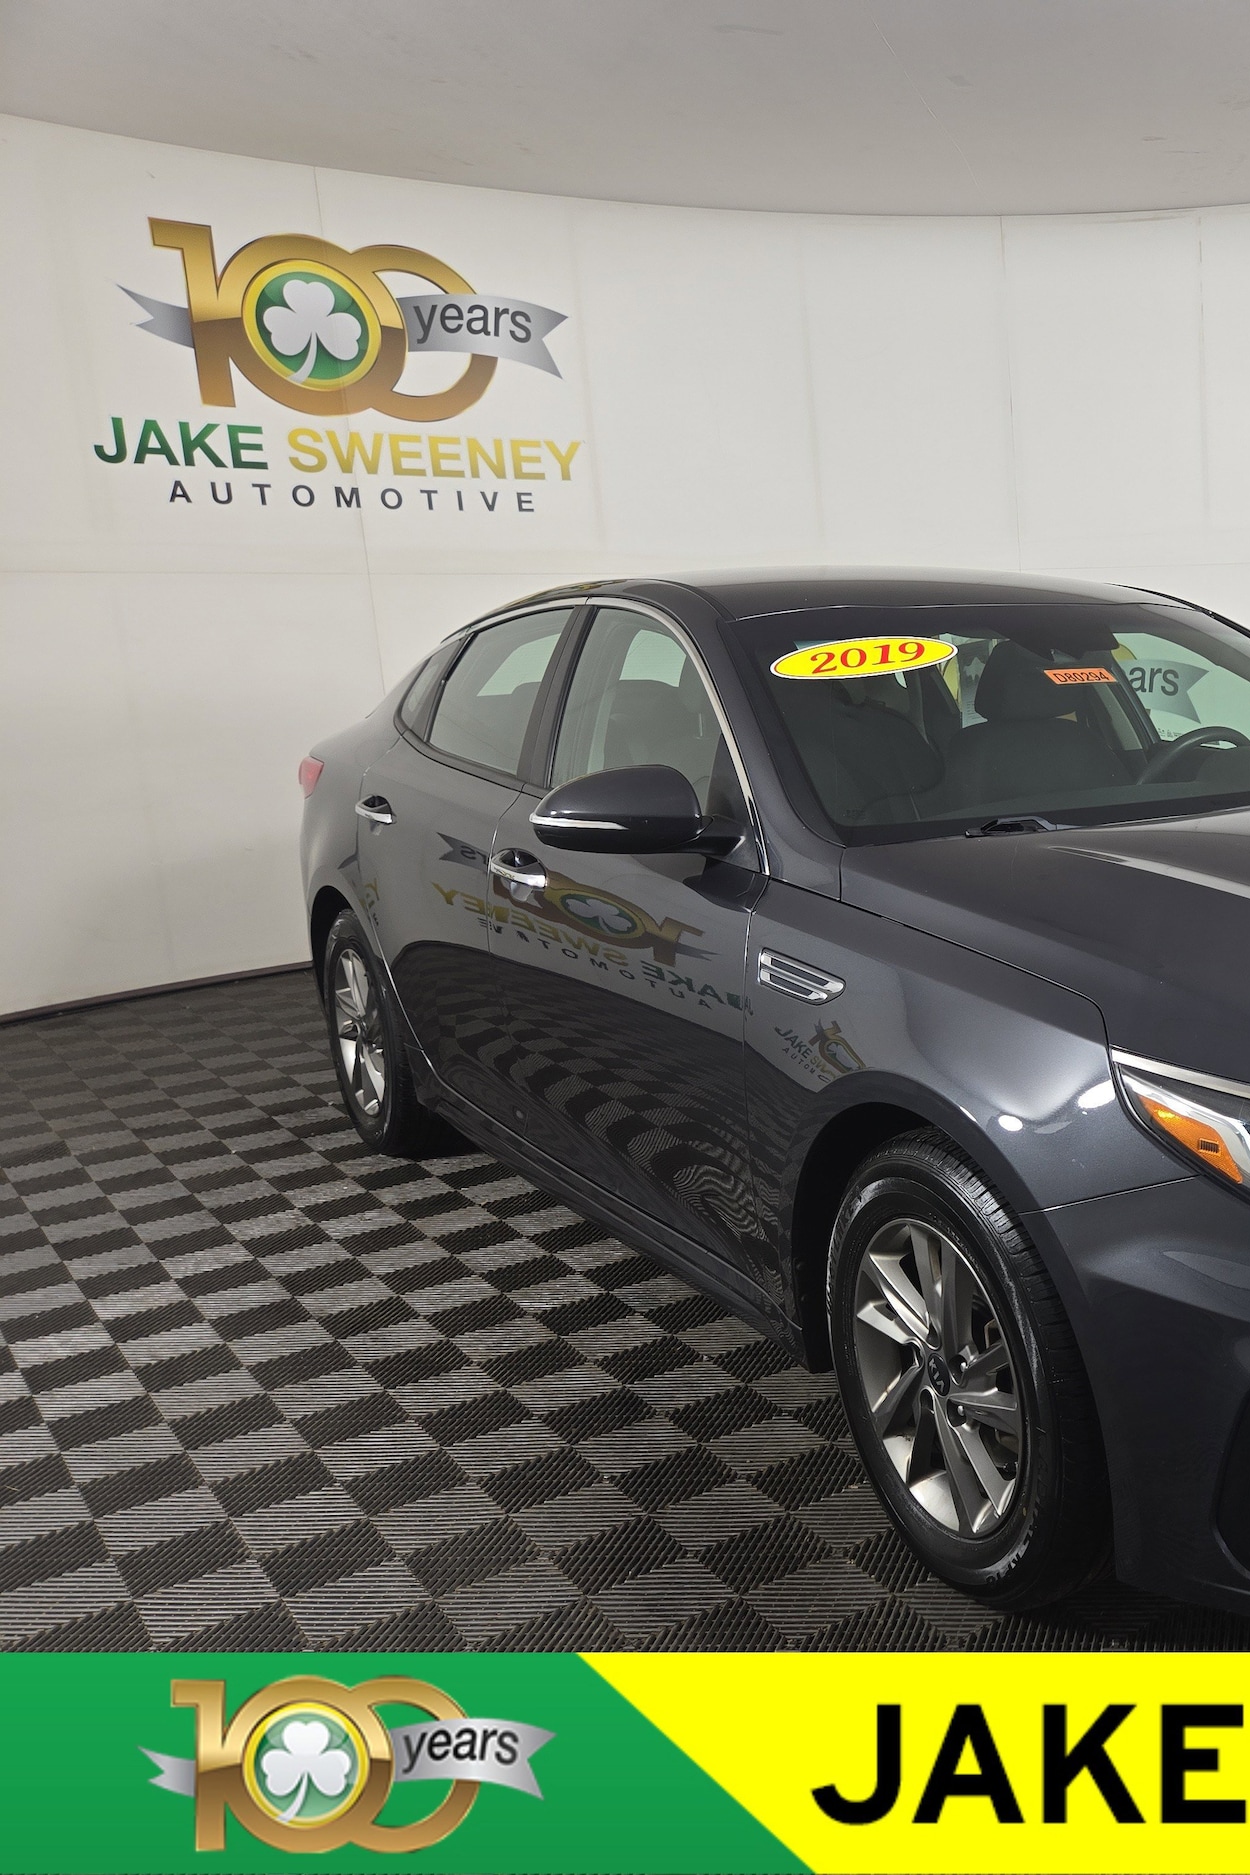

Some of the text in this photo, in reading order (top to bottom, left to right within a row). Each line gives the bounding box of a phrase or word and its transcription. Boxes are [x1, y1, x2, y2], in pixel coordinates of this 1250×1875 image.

[147, 217, 498, 422] 100
[413, 302, 532, 344] years
[93, 416, 582, 481] JAKE SWEENEY
[168, 480, 535, 512] AUTOMOTIVE
[810, 641, 925, 674] 2019
[1053, 671, 1110, 684] D80294
[1128, 666, 1179, 696] ars
